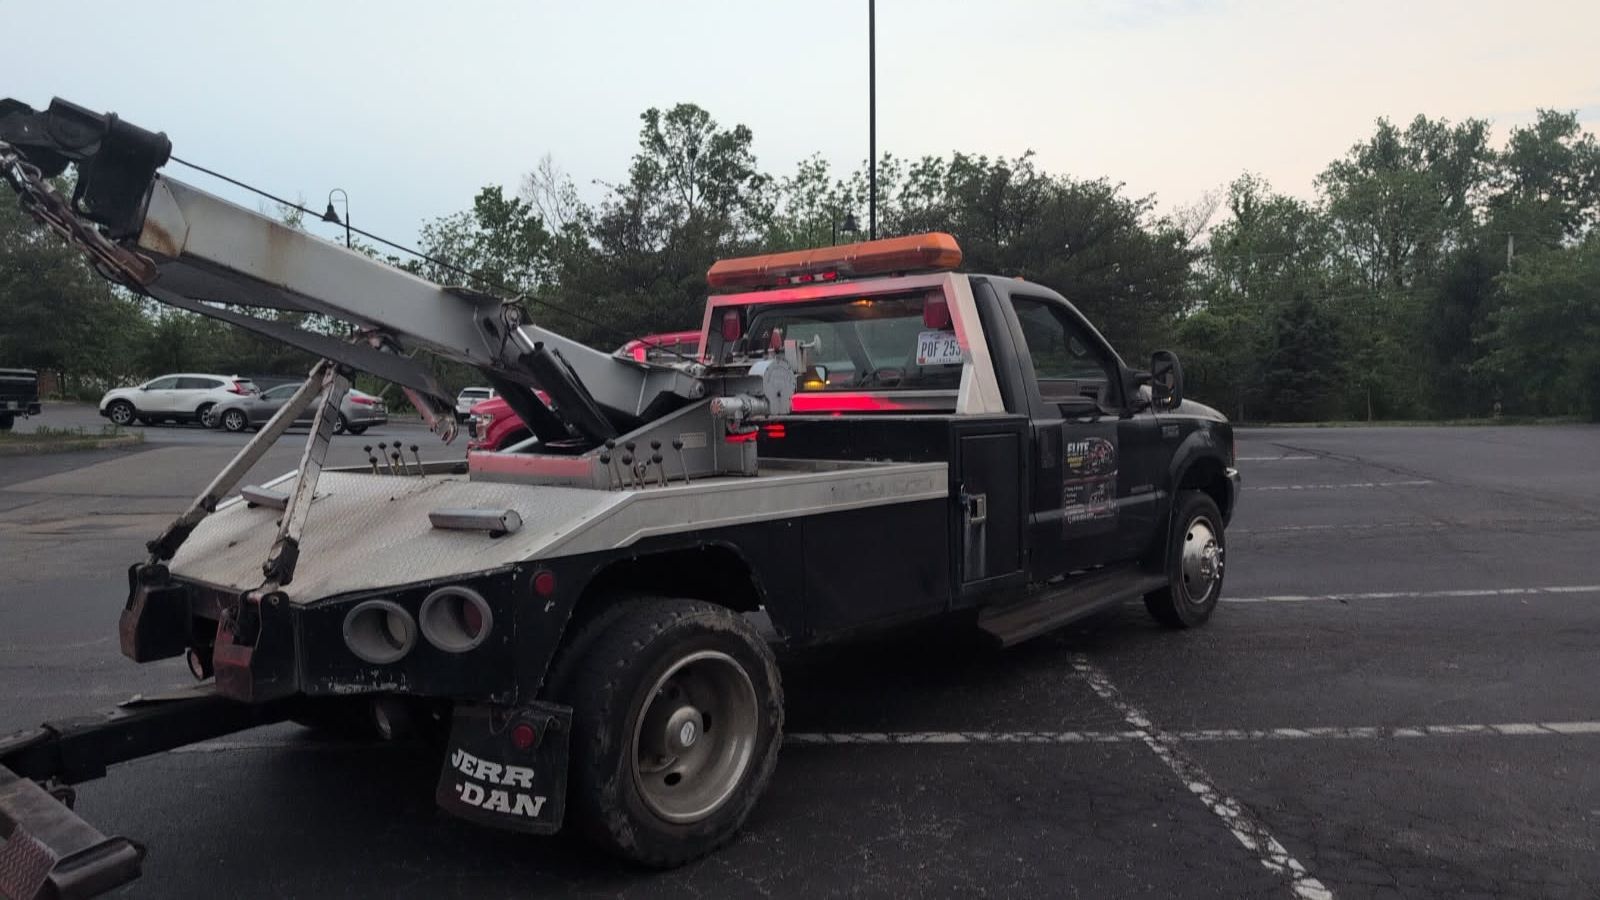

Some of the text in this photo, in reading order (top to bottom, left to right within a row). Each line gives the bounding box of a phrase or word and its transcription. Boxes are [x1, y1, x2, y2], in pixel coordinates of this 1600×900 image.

[921, 340, 940, 358] POF
[1067, 441, 1089, 454] ELITE
[451, 748, 534, 789] JERR
